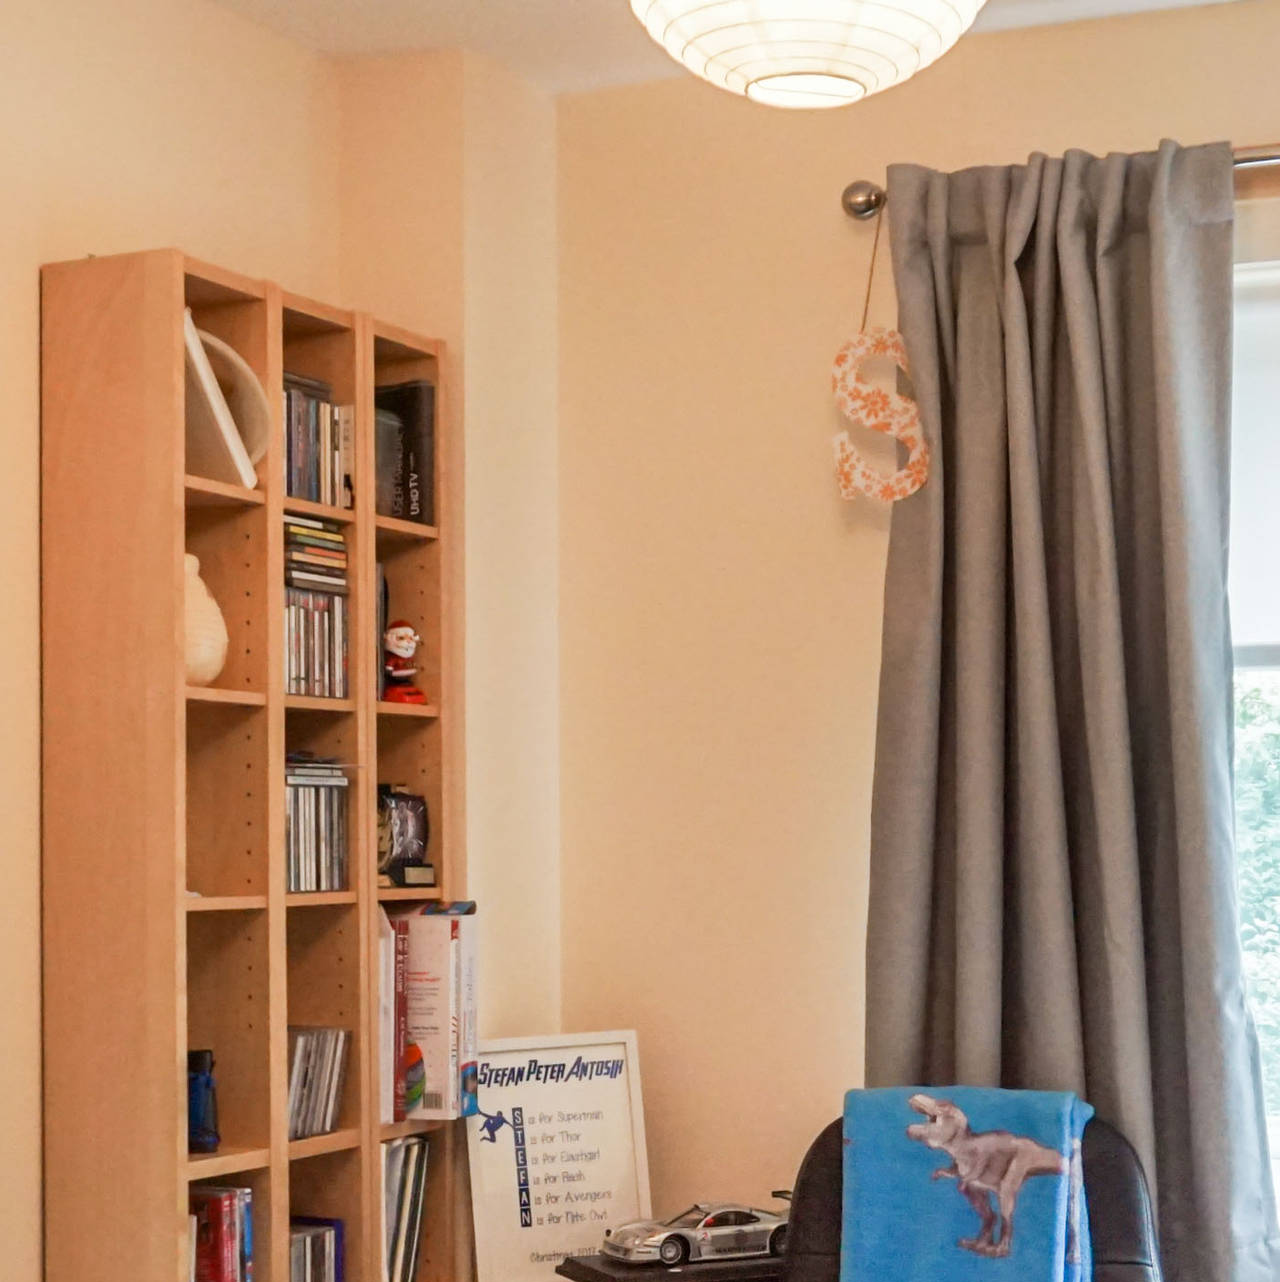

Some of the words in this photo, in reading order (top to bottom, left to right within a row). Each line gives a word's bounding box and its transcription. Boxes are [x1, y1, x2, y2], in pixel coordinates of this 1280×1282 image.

[409, 473, 419, 488] TV
[409, 489, 420, 516] UHD
[526, 1059, 566, 1084] PETER
